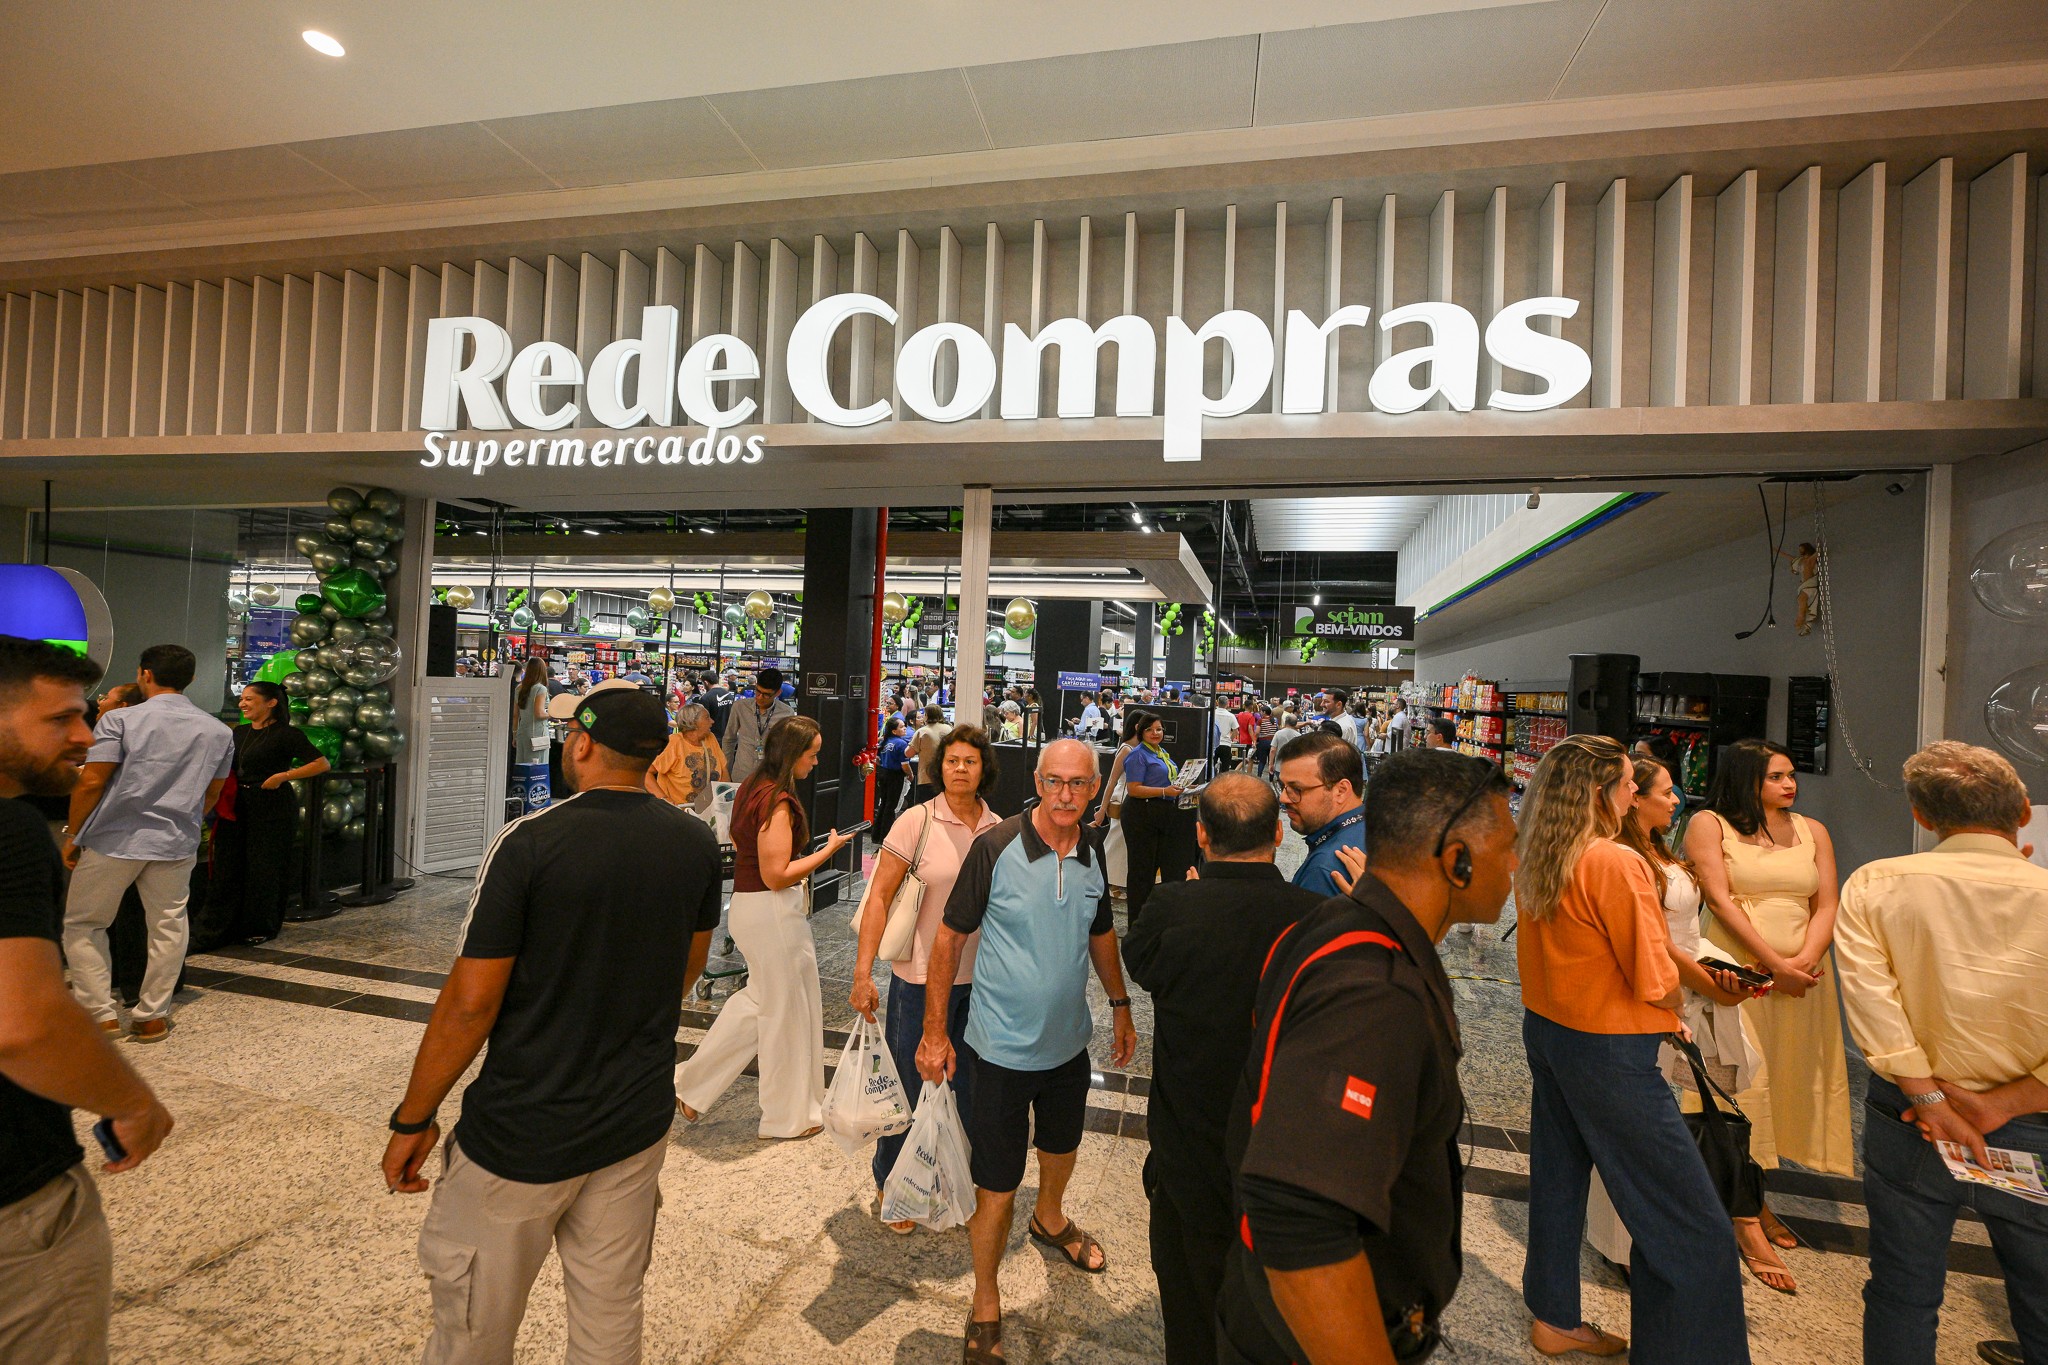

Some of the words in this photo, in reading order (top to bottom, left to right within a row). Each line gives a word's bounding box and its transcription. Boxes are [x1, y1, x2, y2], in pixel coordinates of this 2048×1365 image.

[420, 304, 760, 431] Rede
[786, 291, 1593, 462] Compras
[420, 427, 766, 475] Supermercados
[1327, 606, 1384, 627] sejam
[1315, 623, 1403, 637] BEM-VINDOS
[864, 1078, 898, 1095] Compras
[868, 1075, 889, 1087] Rede
